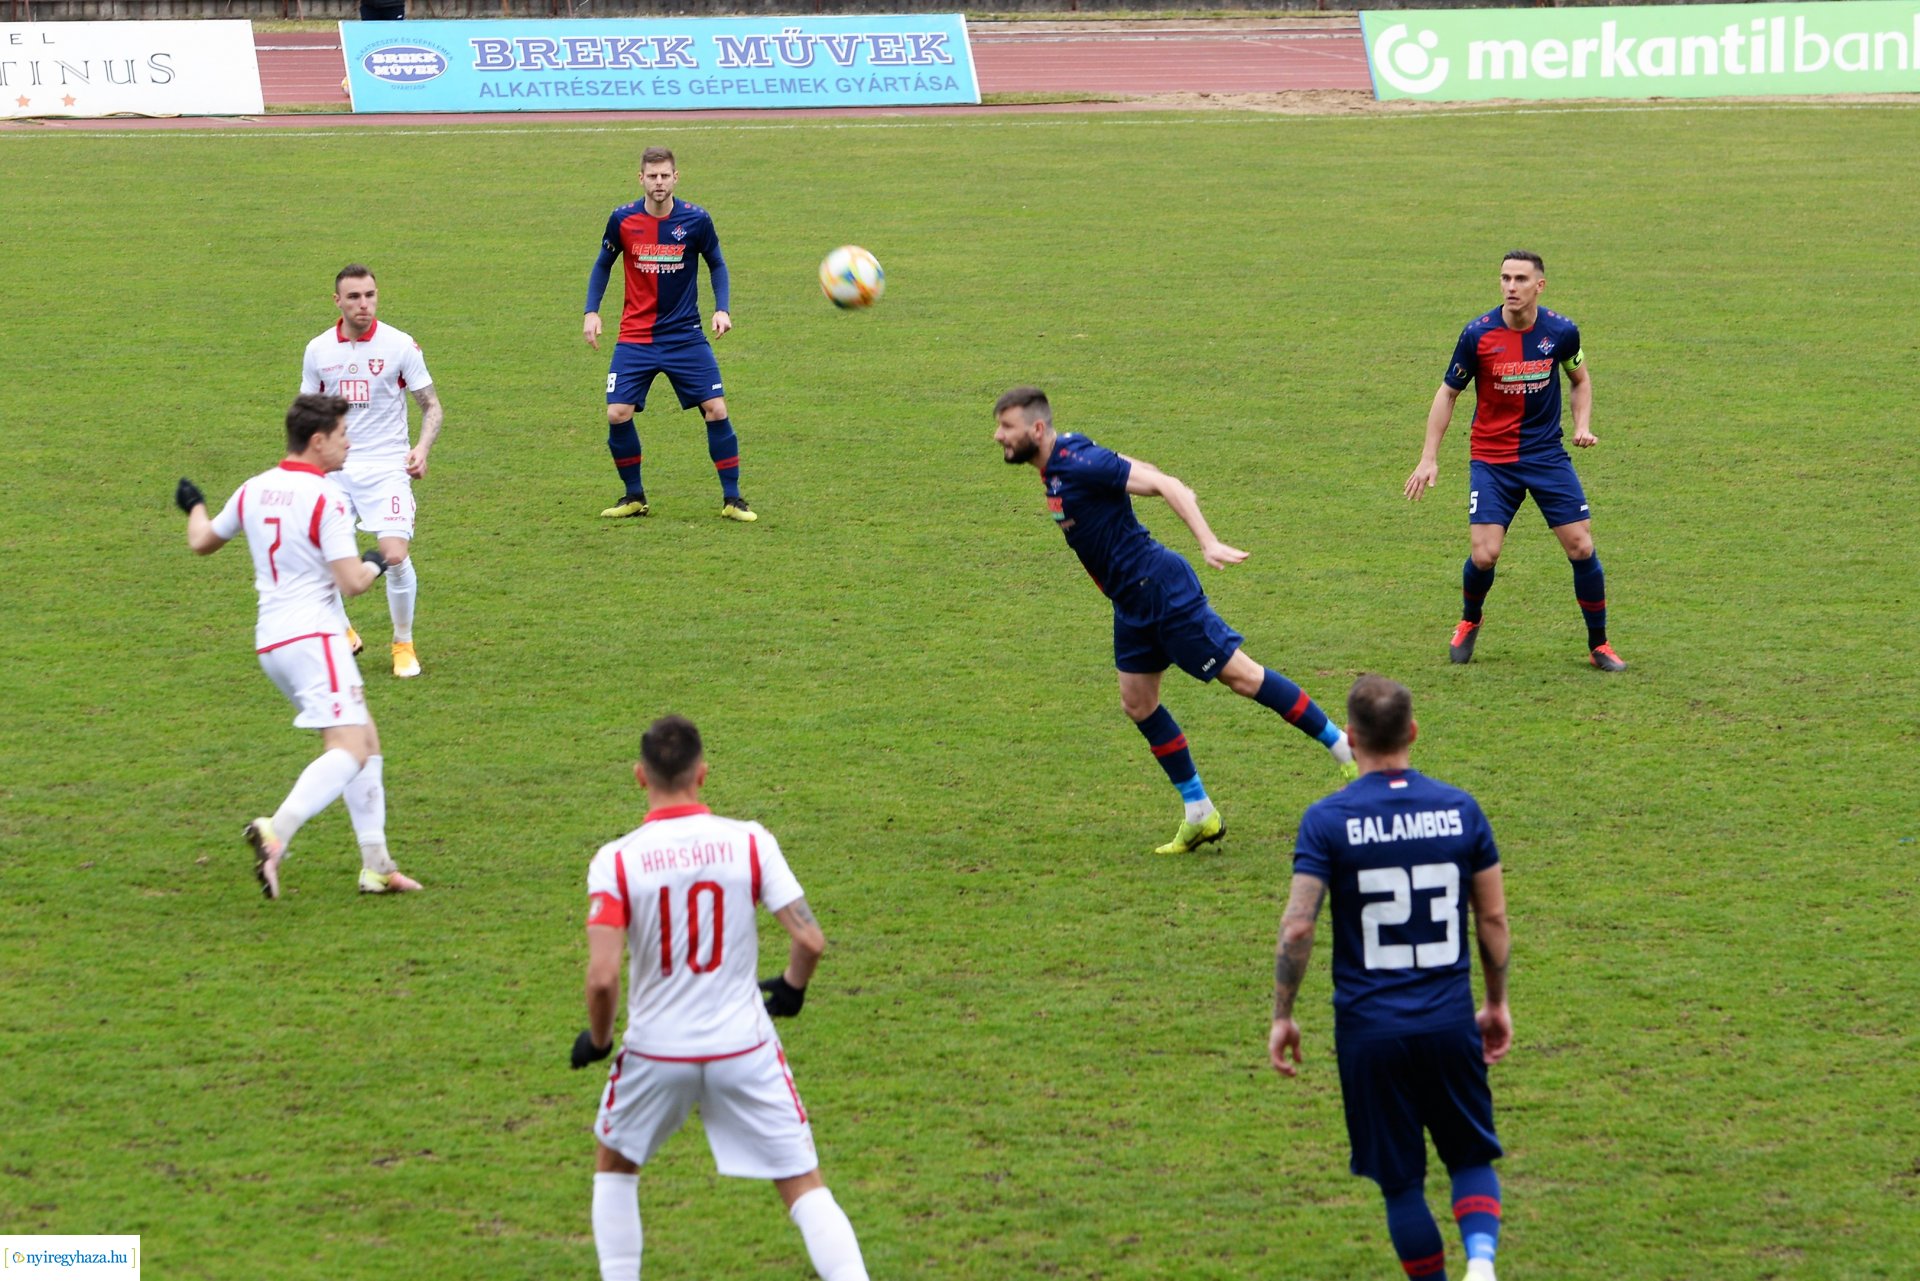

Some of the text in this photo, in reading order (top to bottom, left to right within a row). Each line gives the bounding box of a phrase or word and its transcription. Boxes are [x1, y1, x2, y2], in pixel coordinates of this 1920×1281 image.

[371, 52, 438, 63] BREKK
[469, 27, 955, 70] BREKK MŰVEK
[1467, 13, 1920, 81] merkantilban
[479, 72, 960, 98] ALKATRÉSZEK ÉS GÉPELEMEK GYÁRTÁSA
[632, 243, 686, 257] REVESZ
[1492, 358, 1553, 376] REVESZ
[341, 381, 368, 401] HR
[391, 495, 400, 514] 6
[1469, 490, 1479, 514] 5
[263, 517, 281, 587] 7
[1346, 809, 1463, 846] GALAMBOS
[641, 841, 734, 873] HARSÁNYI
[659, 880, 725, 977] 10
[1357, 862, 1460, 970] 23
